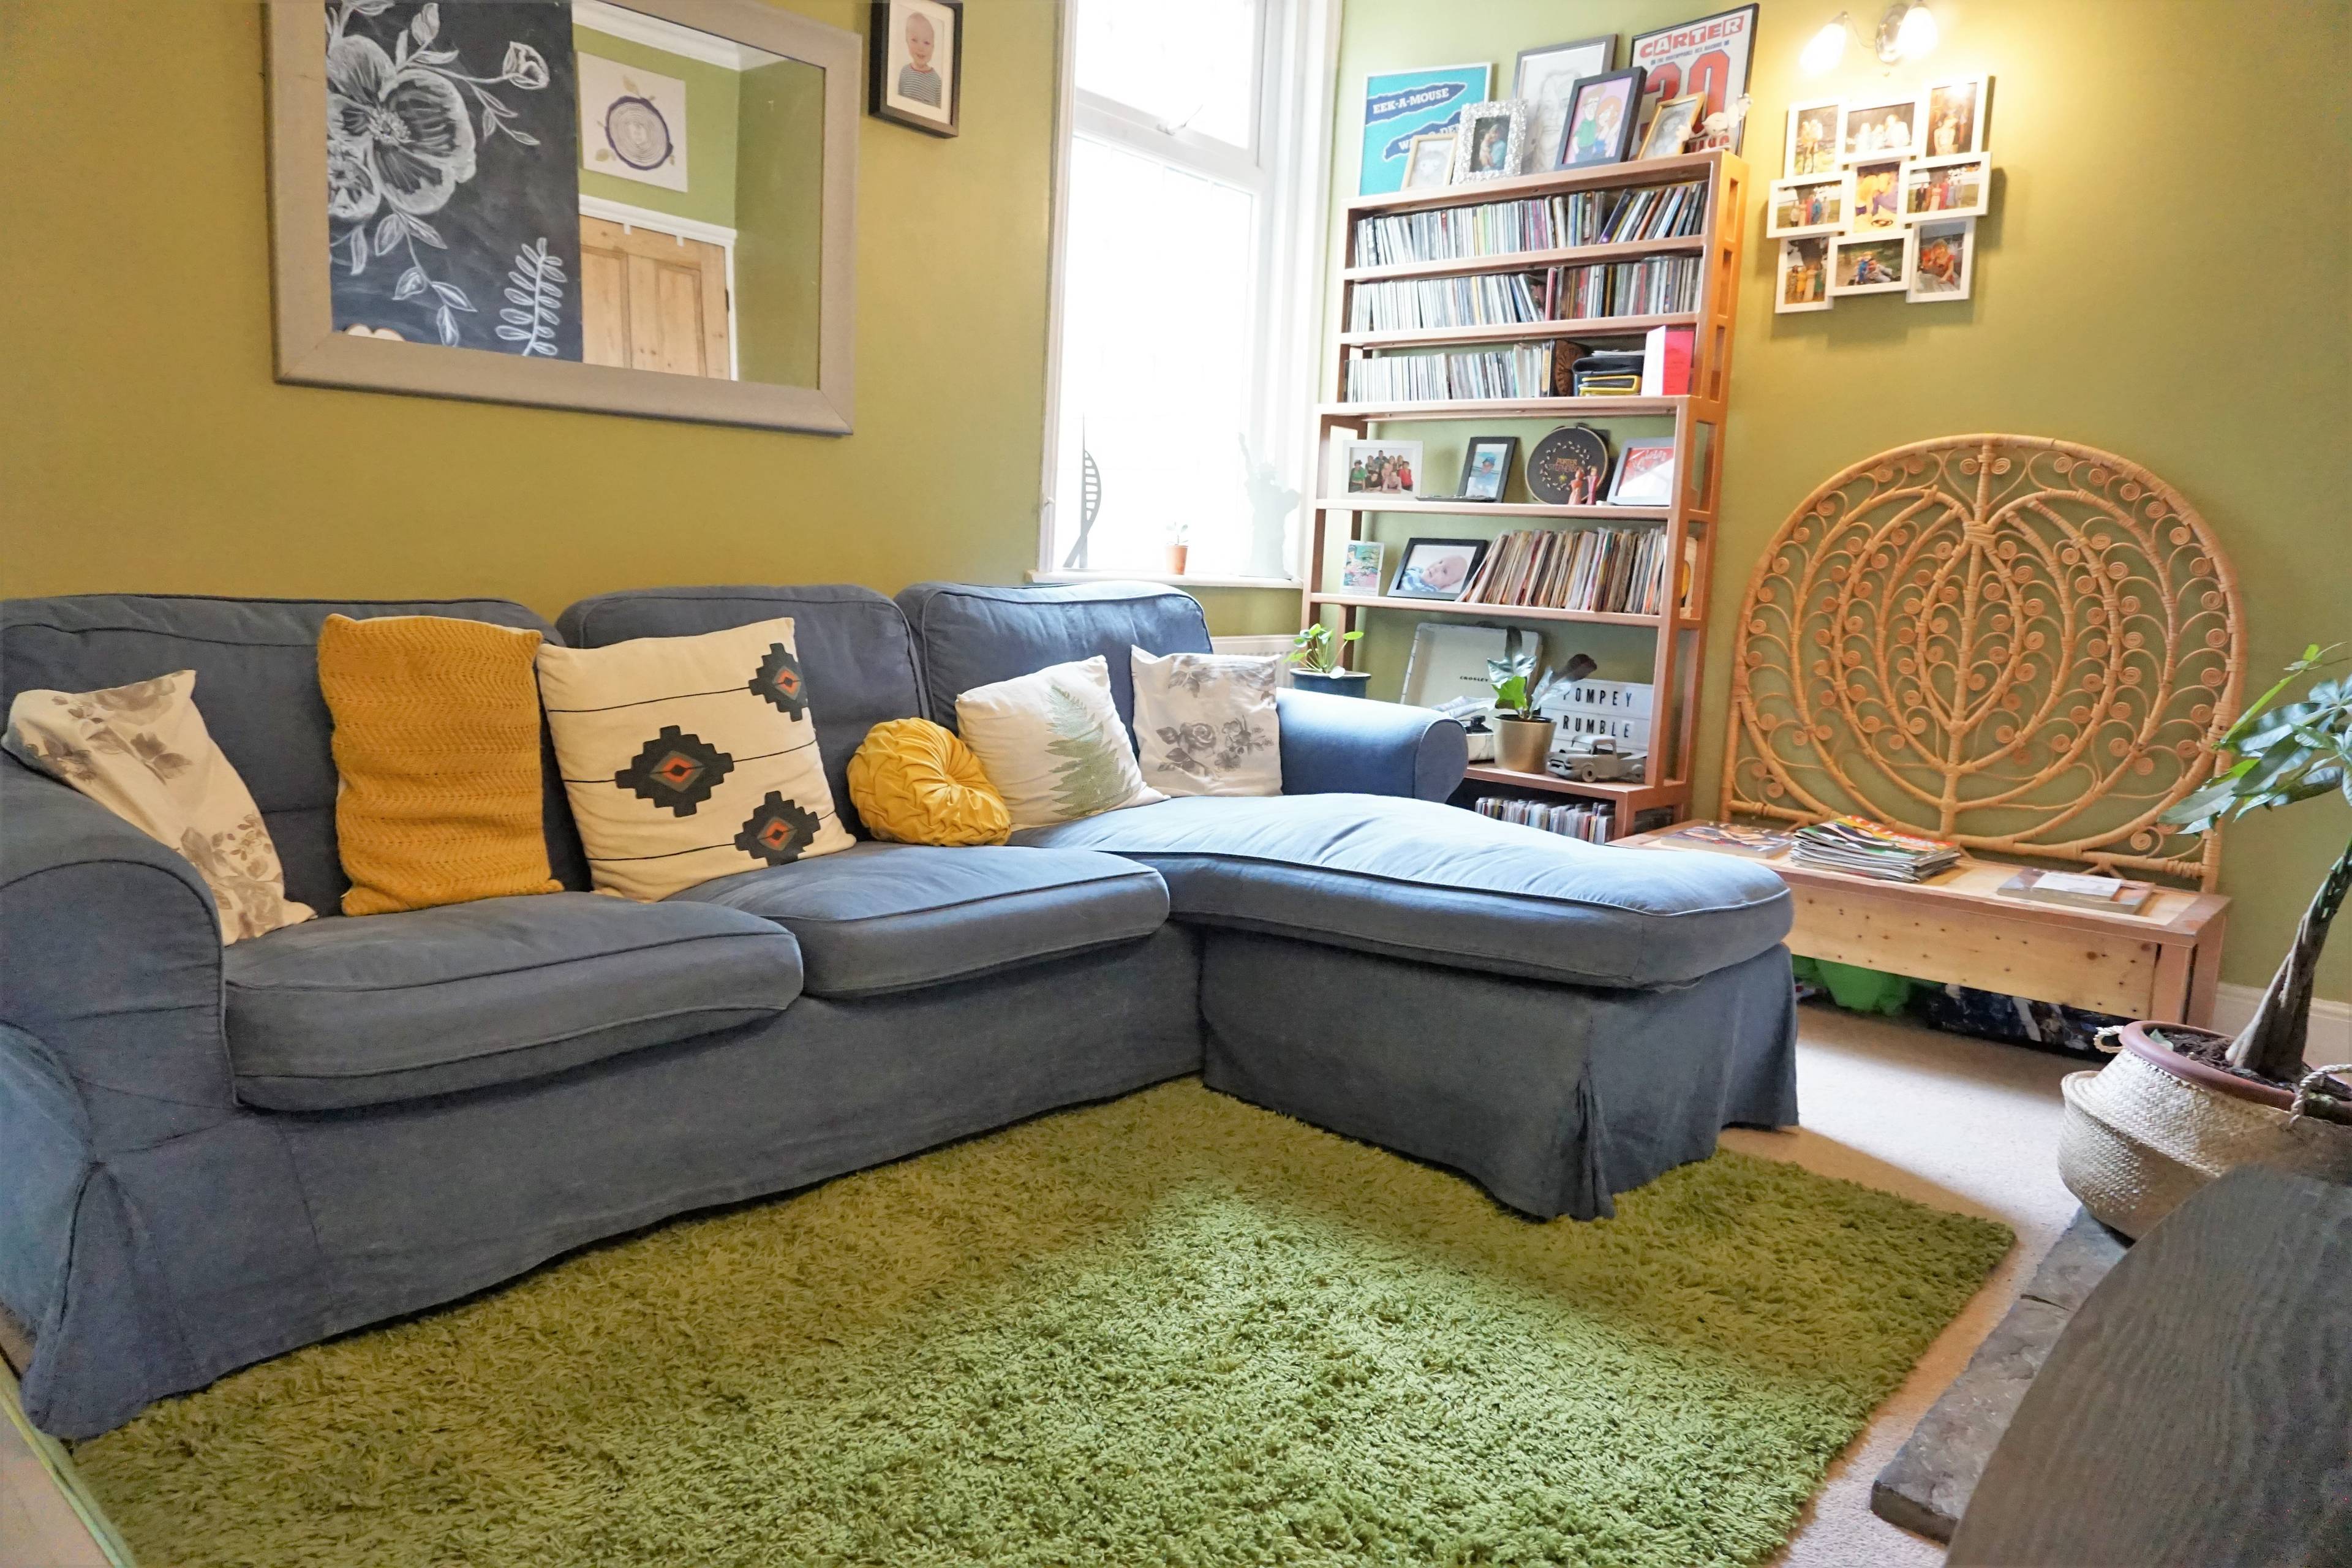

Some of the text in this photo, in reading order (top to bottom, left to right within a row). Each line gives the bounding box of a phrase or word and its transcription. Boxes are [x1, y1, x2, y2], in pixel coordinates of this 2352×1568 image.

[1640, 15, 1744, 58] CARTER
[1372, 88, 1449, 115] EEK-A-MOUSE
[1563, 715, 1630, 738] RUMBLE
